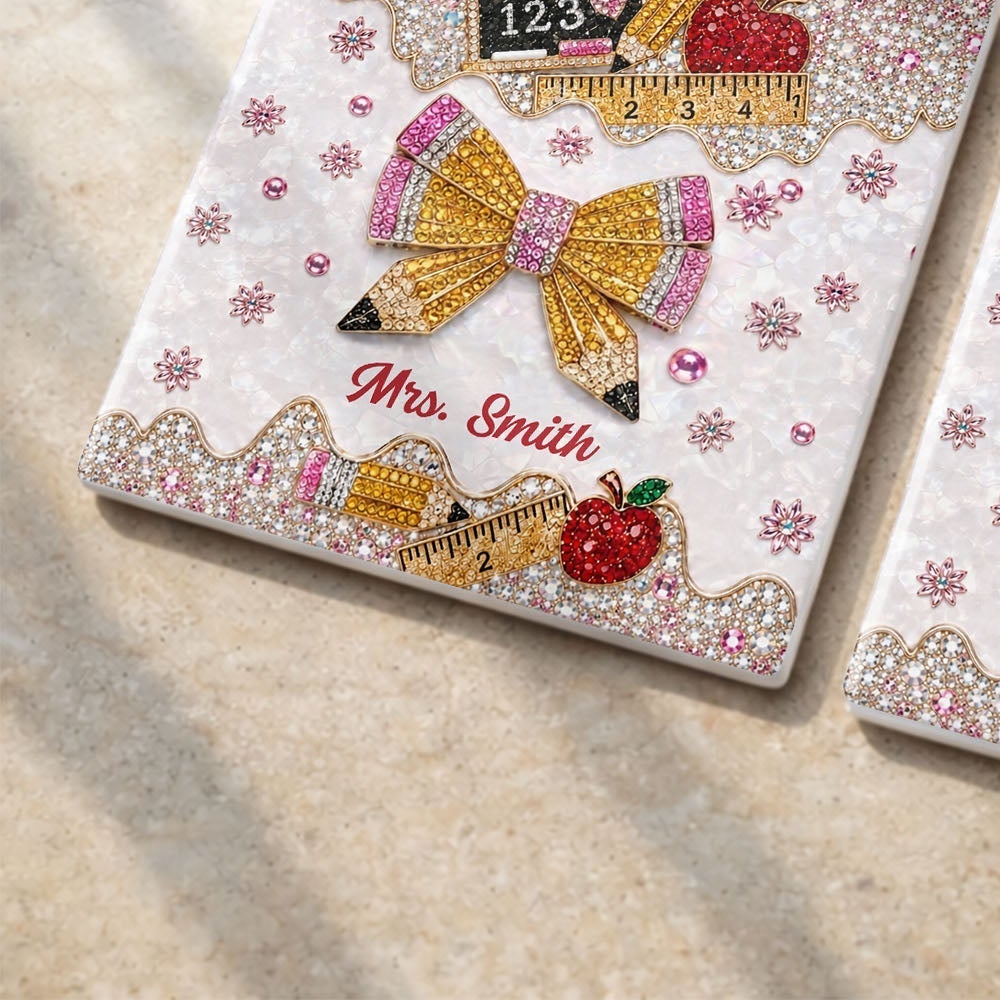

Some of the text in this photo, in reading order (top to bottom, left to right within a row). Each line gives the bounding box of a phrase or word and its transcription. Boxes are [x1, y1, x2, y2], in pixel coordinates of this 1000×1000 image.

[624, 101, 752, 120] 2 3 4
[346, 362, 601, 462] Mrs. Smith
[475, 551, 493, 573] 2
